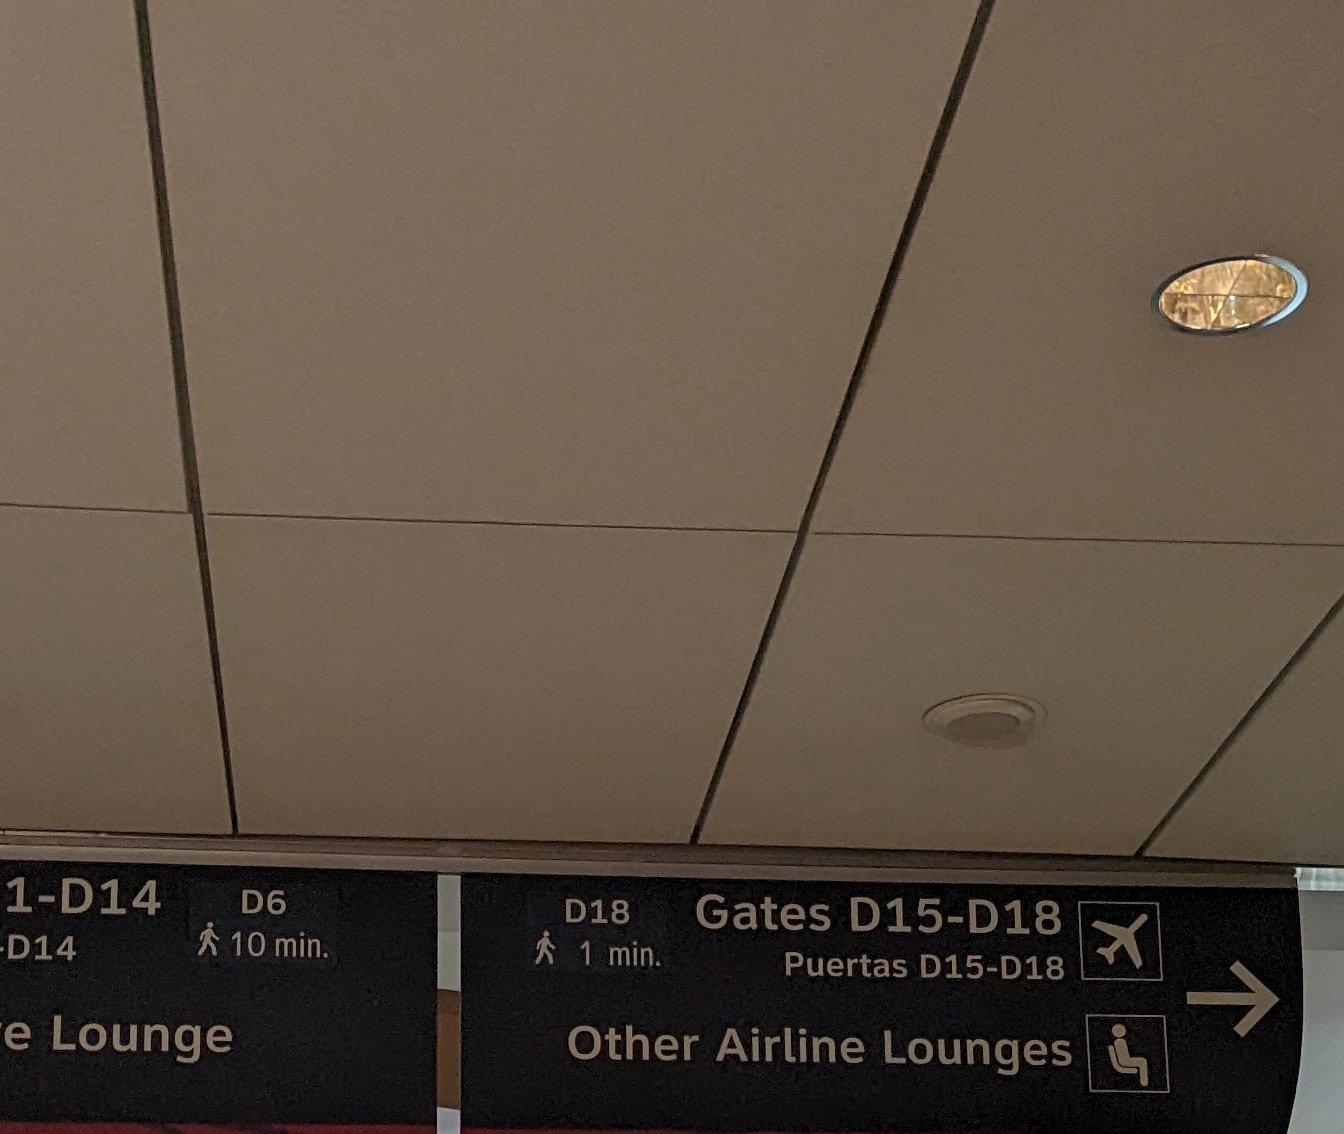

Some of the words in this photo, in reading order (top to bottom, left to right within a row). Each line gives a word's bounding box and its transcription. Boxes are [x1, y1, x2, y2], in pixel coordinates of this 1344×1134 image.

[241, 890, 286, 916] D6
[565, 899, 630, 925] D18
[695, 894, 831, 932] Gates
[851, 897, 1062, 936] D15-D18
[232, 931, 266, 959] 10
[274, 930, 329, 960] min.
[579, 942, 593, 967] 1
[609, 940, 662, 968] min.
[784, 952, 908, 979] Puertas
[920, 954, 1065, 981] D15-D18
[52, 1014, 234, 1063] Lounge
[567, 1025, 699, 1064] Other
[716, 1026, 866, 1065] Airline
[884, 1030, 1073, 1077] Lounges
